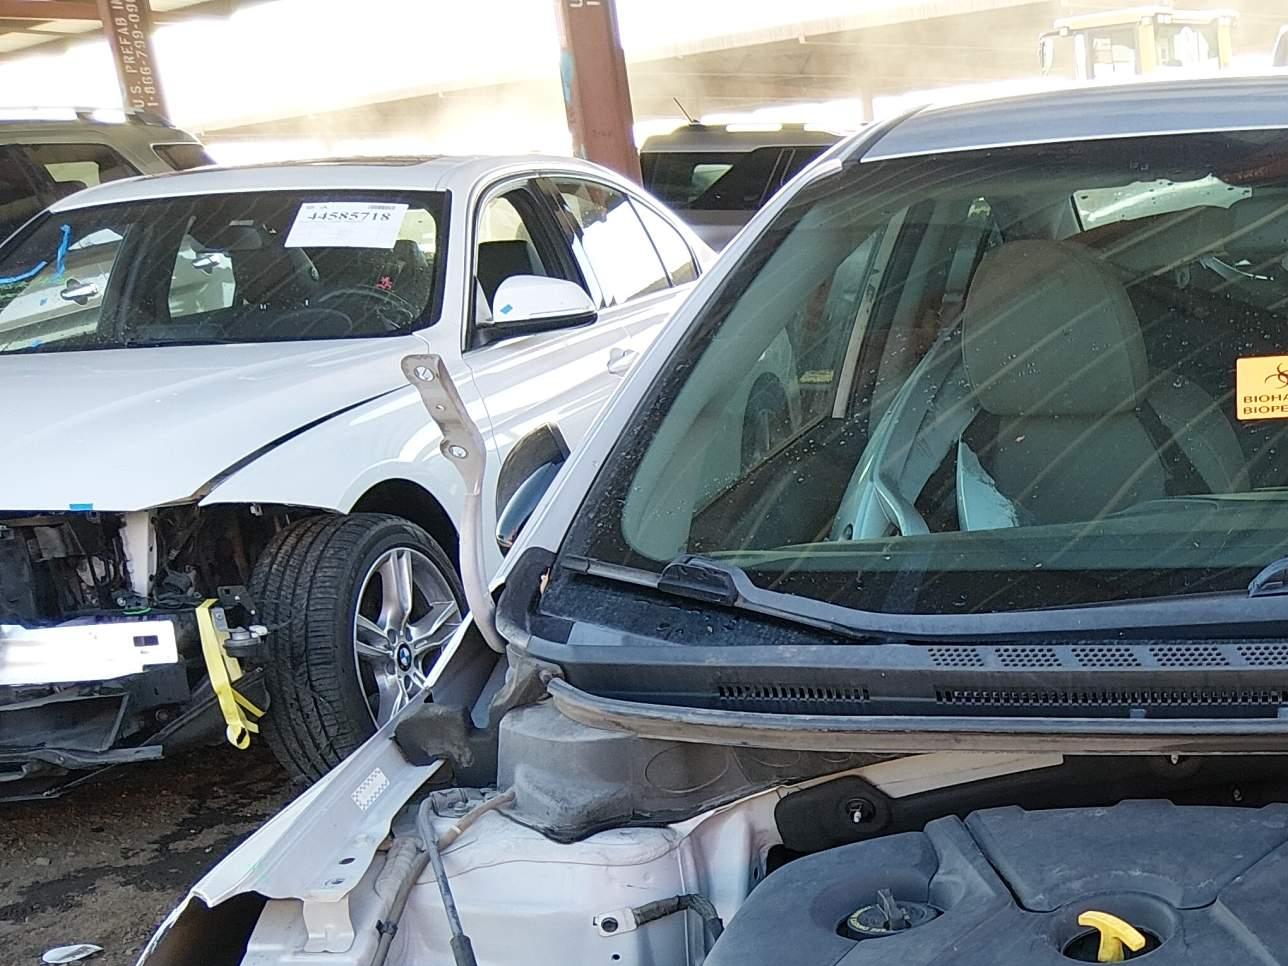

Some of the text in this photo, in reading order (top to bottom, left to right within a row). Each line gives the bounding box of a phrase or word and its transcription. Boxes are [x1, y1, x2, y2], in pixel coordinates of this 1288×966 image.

[114, 17, 138, 73] PREFAB
[130, 81, 145, 108] U.S.
[307, 211, 391, 221] 44585718
